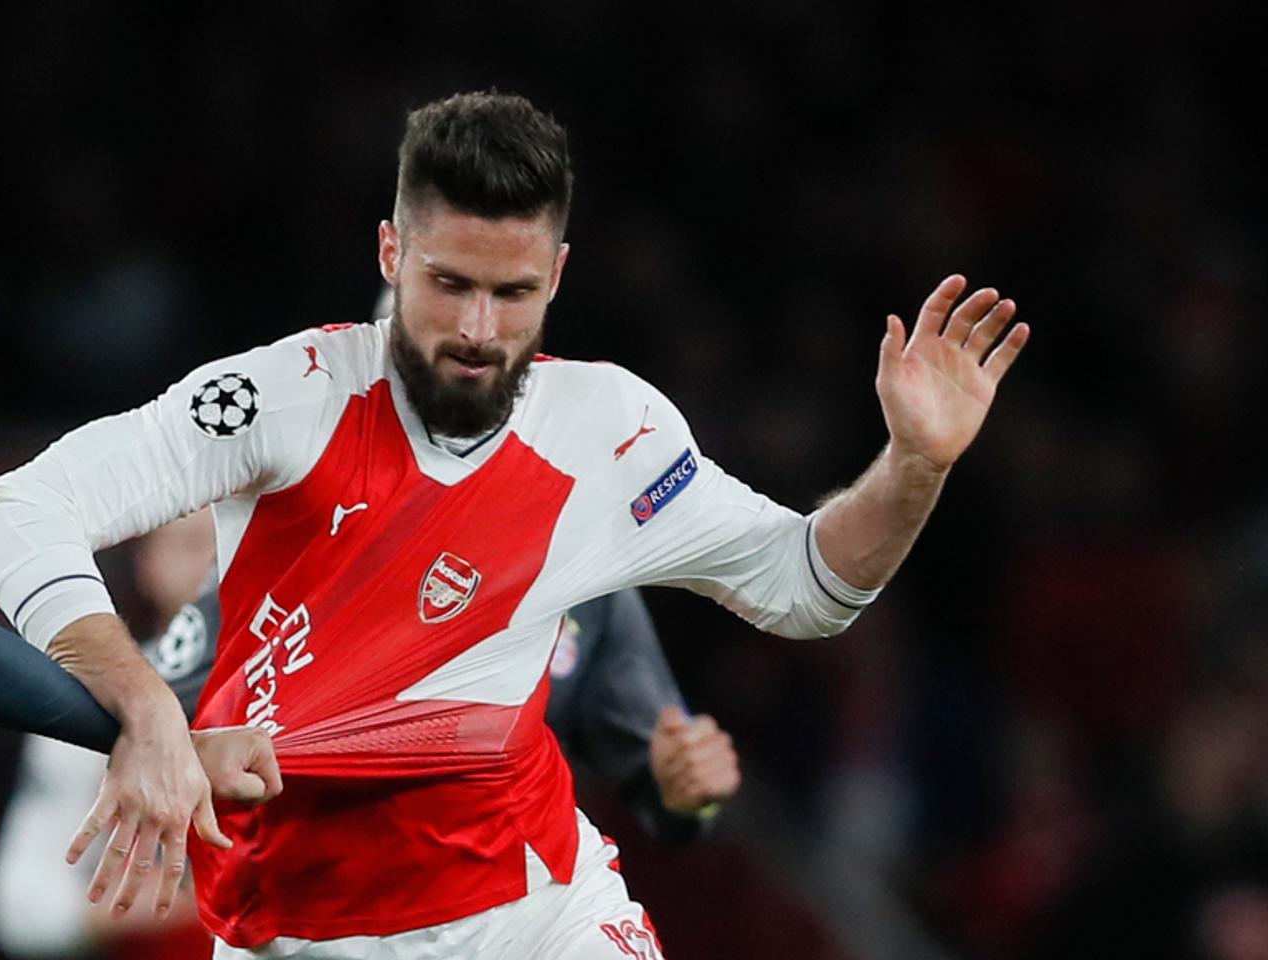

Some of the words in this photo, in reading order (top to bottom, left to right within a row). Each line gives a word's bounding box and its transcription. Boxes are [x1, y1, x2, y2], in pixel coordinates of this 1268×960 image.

[649, 455, 696, 505] RESPECT
[244, 592, 286, 738] Eirat
[280, 603, 315, 675] Fly
